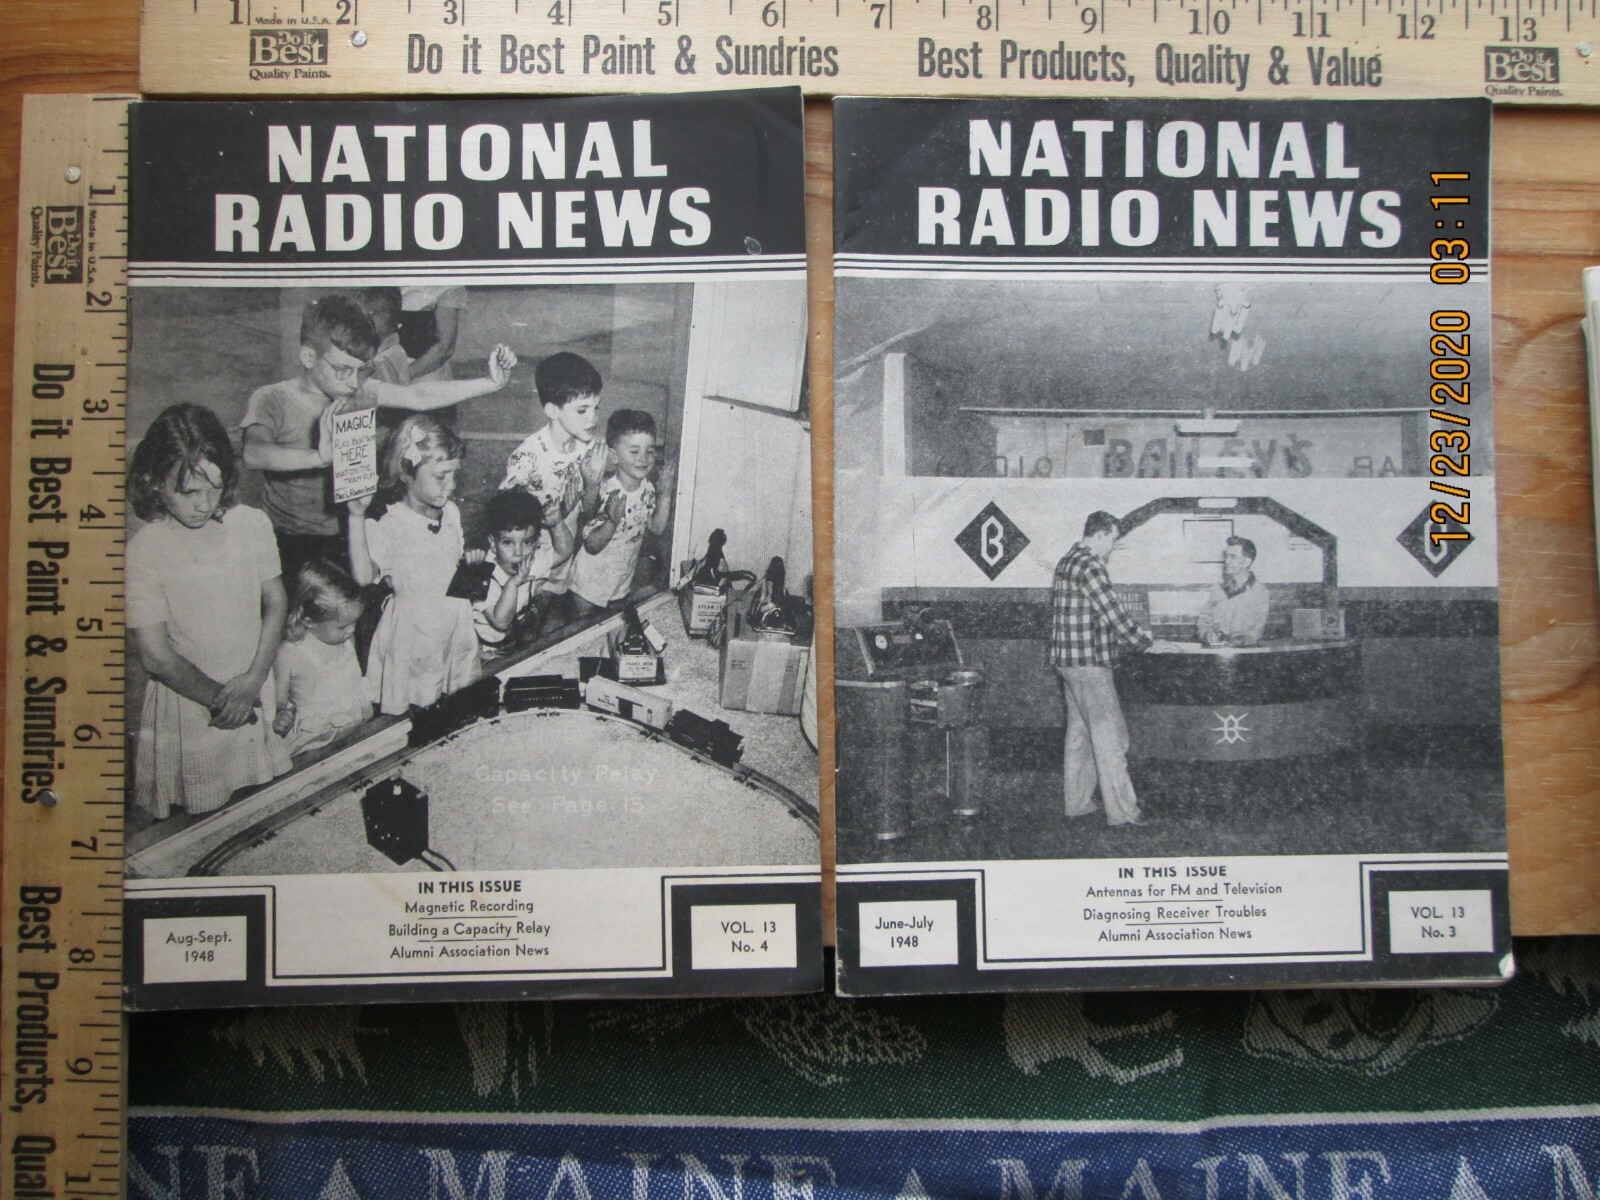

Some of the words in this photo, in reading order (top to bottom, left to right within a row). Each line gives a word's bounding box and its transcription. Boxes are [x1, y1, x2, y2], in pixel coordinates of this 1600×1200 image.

[229, 0, 243, 24] 1
[336, 0, 352, 24] 2
[444, 0, 458, 24] 3
[547, 0, 565, 26] 4
[658, 1, 672, 26] 5
[762, 1, 779, 27] 6
[870, 3, 886, 29] 7
[976, 5, 992, 30] 8
[1080, 7, 1098, 33] 9
[1188, 8, 1231, 35] 10
[1292, 12, 1331, 38] 11
[1396, 14, 1435, 40] 12
[1499, 16, 1538, 42] 13
[287, 16, 296, 24] in
[278, 30, 300, 44] Do
[252, 34, 324, 64] Best
[408, 34, 442, 74] Do
[462, 34, 482, 74] it
[500, 34, 565, 75] Best
[582, 34, 656, 75] Paint
[674, 34, 696, 75] &
[716, 34, 840, 77] Sundries
[918, 37, 982, 79] Best
[1000, 39, 1135, 88] Products,
[1155, 42, 1250, 92] Quality
[1268, 45, 1290, 86] &
[1306, 46, 1383, 88] Value
[1486, 52, 1557, 82] Best
[249, 68, 290, 80] Quality
[1484, 84, 1525, 96] Quality
[268, 120, 668, 182] NATIONAL
[968, 119, 1360, 178] NATIONAL
[90, 184, 116, 199] 1
[89, 210, 97, 238] Made
[214, 193, 464, 252] RADIO
[498, 187, 712, 249] NEWS
[918, 186, 1160, 246] RADIO
[1193, 189, 1402, 248] NEWS
[30, 206, 44, 248] Quality
[47, 208, 78, 280] Best
[88, 242, 96, 252] in
[86, 292, 112, 306] 2
[32, 364, 75, 399] Do
[83, 398, 109, 414] 3
[30, 419, 73, 440] it
[336, 410, 375, 434] MAGIC!
[340, 444, 368, 462] HERE
[28, 457, 72, 523] Best
[80, 504, 106, 522] 4
[26, 541, 70, 615] Paint
[77, 617, 103, 632] 5
[25, 635, 68, 657] &
[21, 676, 67, 804] Sundries
[74, 724, 102, 742] 6
[475, 764, 581, 786] Capacity
[596, 764, 658, 785] Relay
[492, 796, 532, 814] See
[552, 795, 608, 816] Page
[71, 836, 98, 852] 7
[1119, 867, 1133, 878] IN
[1143, 867, 1177, 878] THIS
[1186, 866, 1227, 877] ISSUE
[419, 882, 434, 894] IN
[439, 881, 474, 893] THIS
[480, 880, 522, 893] ISSUE
[1086, 886, 1142, 898] Antennas
[1147, 884, 1165, 897] for
[1171, 884, 1190, 896] FM
[1196, 883, 1218, 895] and
[1223, 882, 1282, 894] Television
[405, 900, 465, 915] Magnetic
[470, 899, 534, 913] Recording
[1083, 907, 1150, 922] Diagnosing
[1157, 906, 1210, 919] Receiver
[1216, 905, 1266, 918] Troubles
[1411, 906, 1443, 919] VOL.
[1452, 906, 1464, 918] 13
[18, 886, 62, 953] Best
[721, 921, 754, 933] VOL.
[764, 921, 776, 933] 13
[875, 916, 934, 932] June-July
[166, 931, 232, 947] Aug-Sept.
[389, 924, 438, 939] Building
[442, 927, 449, 935] a
[454, 922, 512, 937] Capacity
[517, 921, 550, 936] Relay
[1098, 930, 1140, 942] Alumni
[1145, 928, 1214, 941] Association
[1220, 927, 1252, 939] News
[1422, 926, 1444, 938] No.
[1449, 926, 1456, 937] 3
[390, 946, 434, 958] Alumni
[439, 945, 510, 958] Association
[516, 944, 549, 956] News
[731, 940, 754, 952] No.
[760, 940, 768, 952] 4
[890, 936, 919, 948] 1948
[68, 947, 95, 963] 8
[185, 950, 214, 963] 1948
[9, 971, 60, 1113] Products,
[66, 1057, 93, 1075] 9
